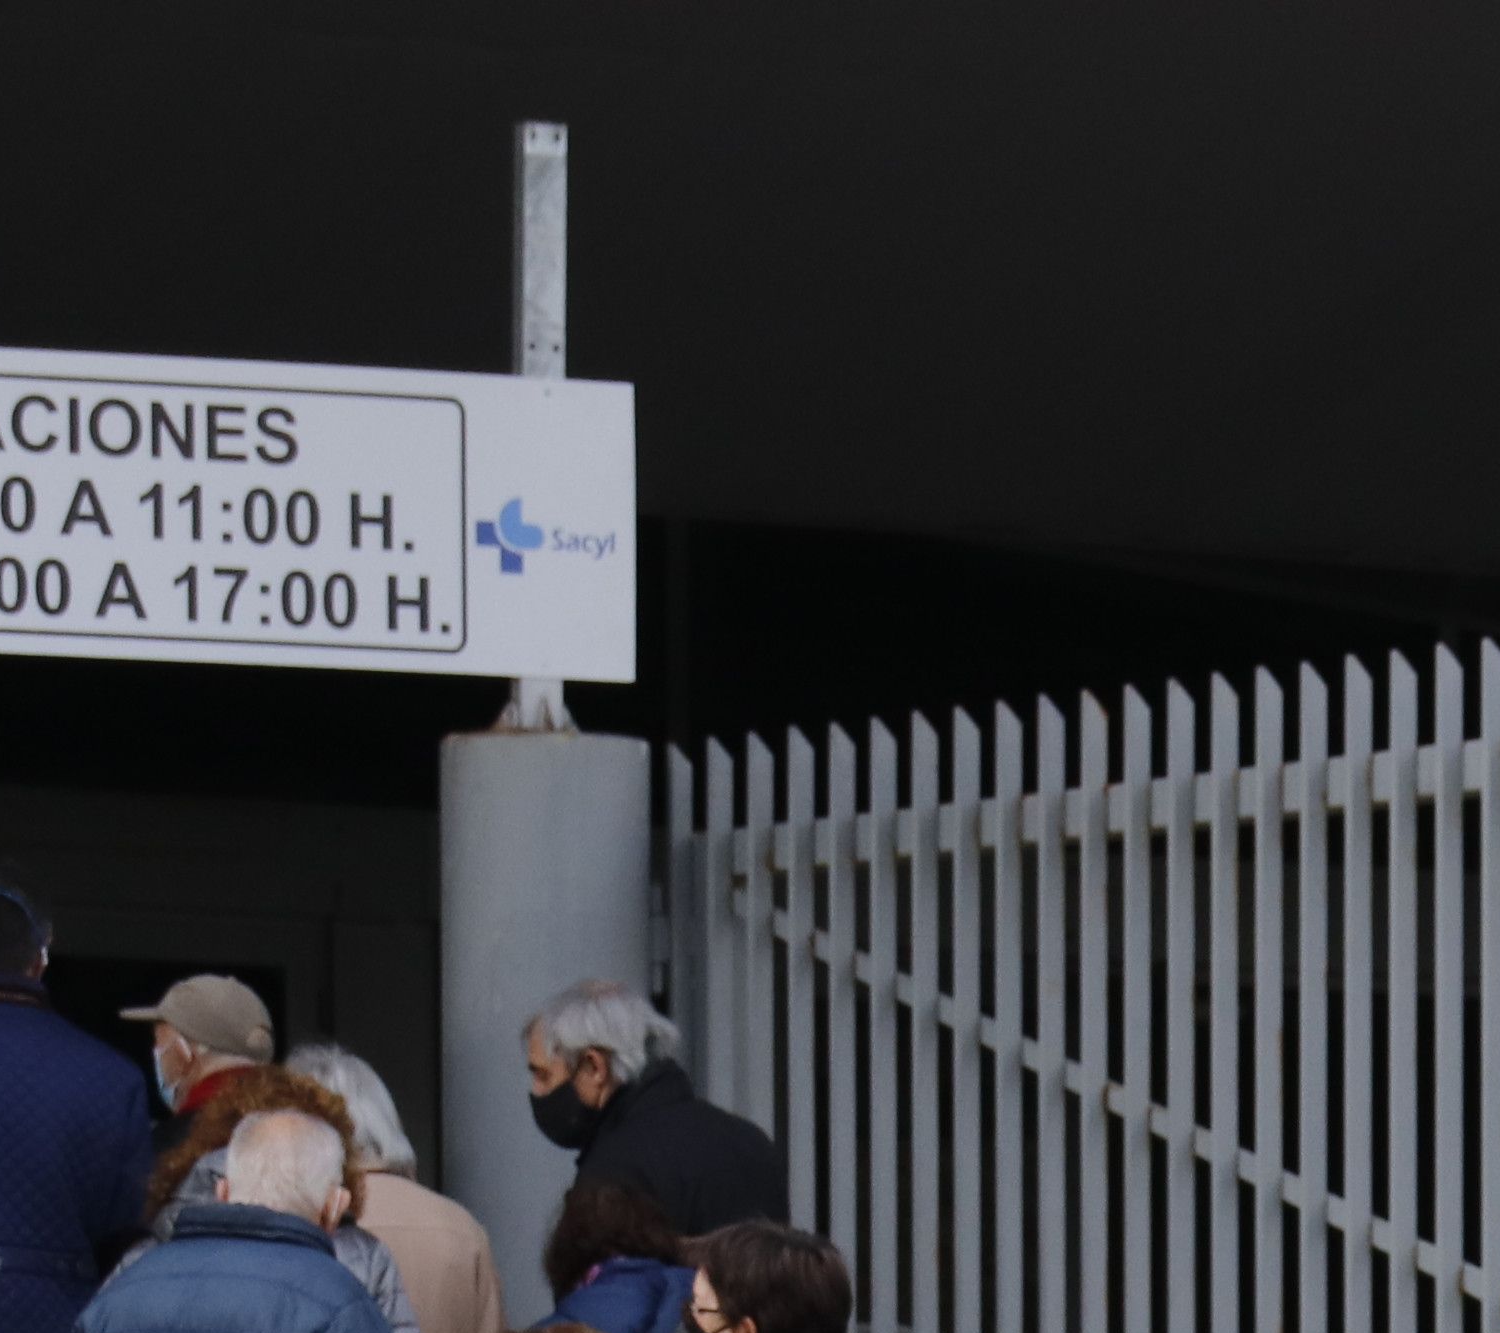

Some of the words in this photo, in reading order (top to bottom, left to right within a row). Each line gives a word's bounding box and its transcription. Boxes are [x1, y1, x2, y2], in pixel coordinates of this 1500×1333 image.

[60, 478, 113, 537] A
[138, 482, 321, 547] 11:00
[349, 492, 415, 552] H.
[551, 526, 617, 561] Sacyl
[95, 561, 148, 621] A
[173, 565, 358, 630] 17:00
[385, 574, 451, 634] H.
